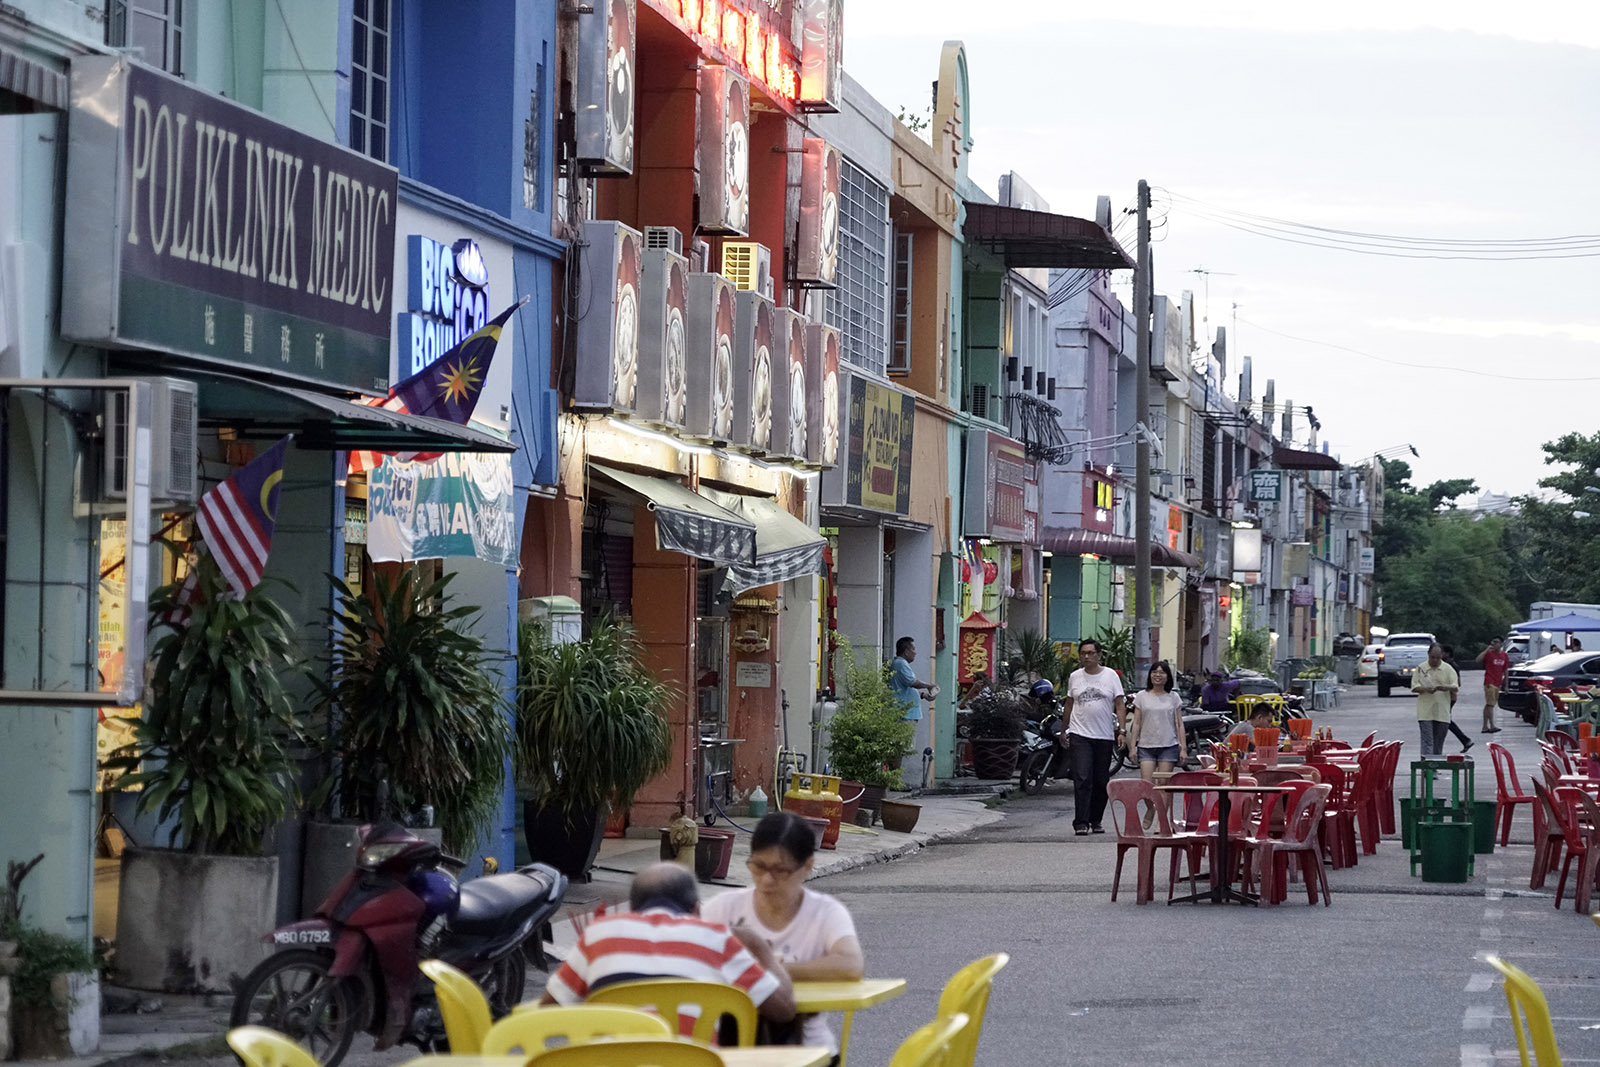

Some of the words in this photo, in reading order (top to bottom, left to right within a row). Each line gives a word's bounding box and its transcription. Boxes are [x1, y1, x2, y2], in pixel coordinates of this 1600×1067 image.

[127, 95, 303, 289] POLIKLINIK
[306, 164, 389, 314] MEDIC
[299, 930, 330, 943] 6752
